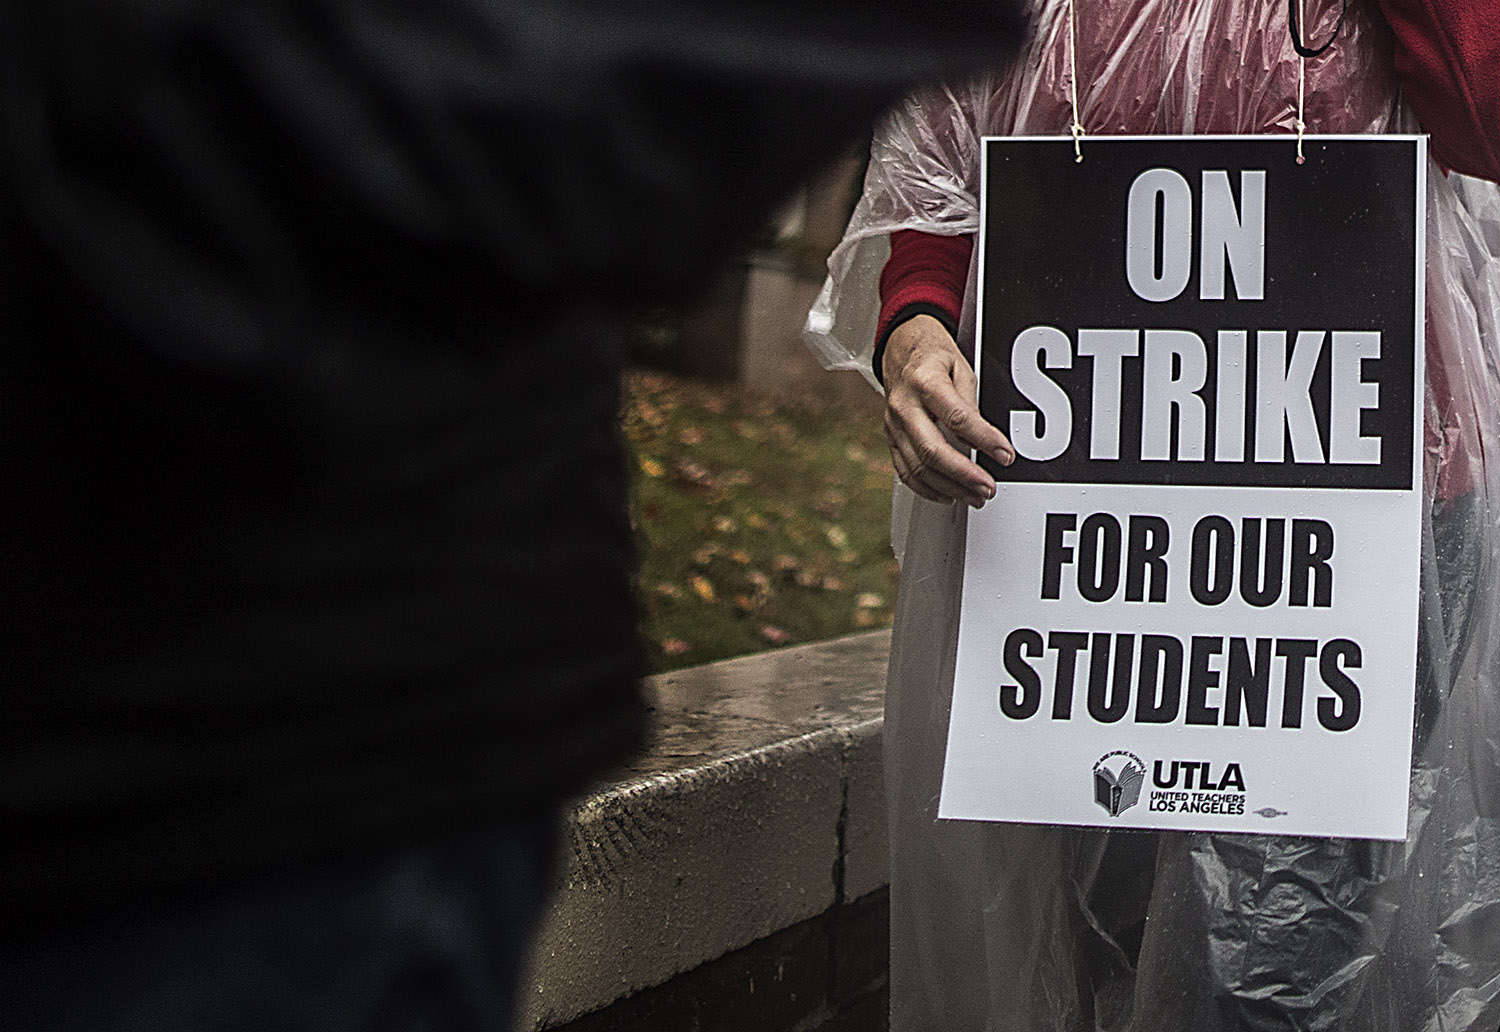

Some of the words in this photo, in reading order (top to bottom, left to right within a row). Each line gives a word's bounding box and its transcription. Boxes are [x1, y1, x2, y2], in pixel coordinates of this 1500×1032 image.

[1127, 169, 1266, 301] ON
[1010, 326, 1381, 464] STRIKE
[1041, 513, 1169, 603] FOR
[1190, 515, 1334, 607] OUR
[1000, 629, 1362, 732] STUDENTS
[1149, 800, 1176, 812] LOS
[1179, 801, 1245, 815] ANGELES
[1150, 791, 1189, 802] UNITED
[1191, 793, 1246, 804] TEACHERS
[1153, 760, 1246, 791] UTLA
